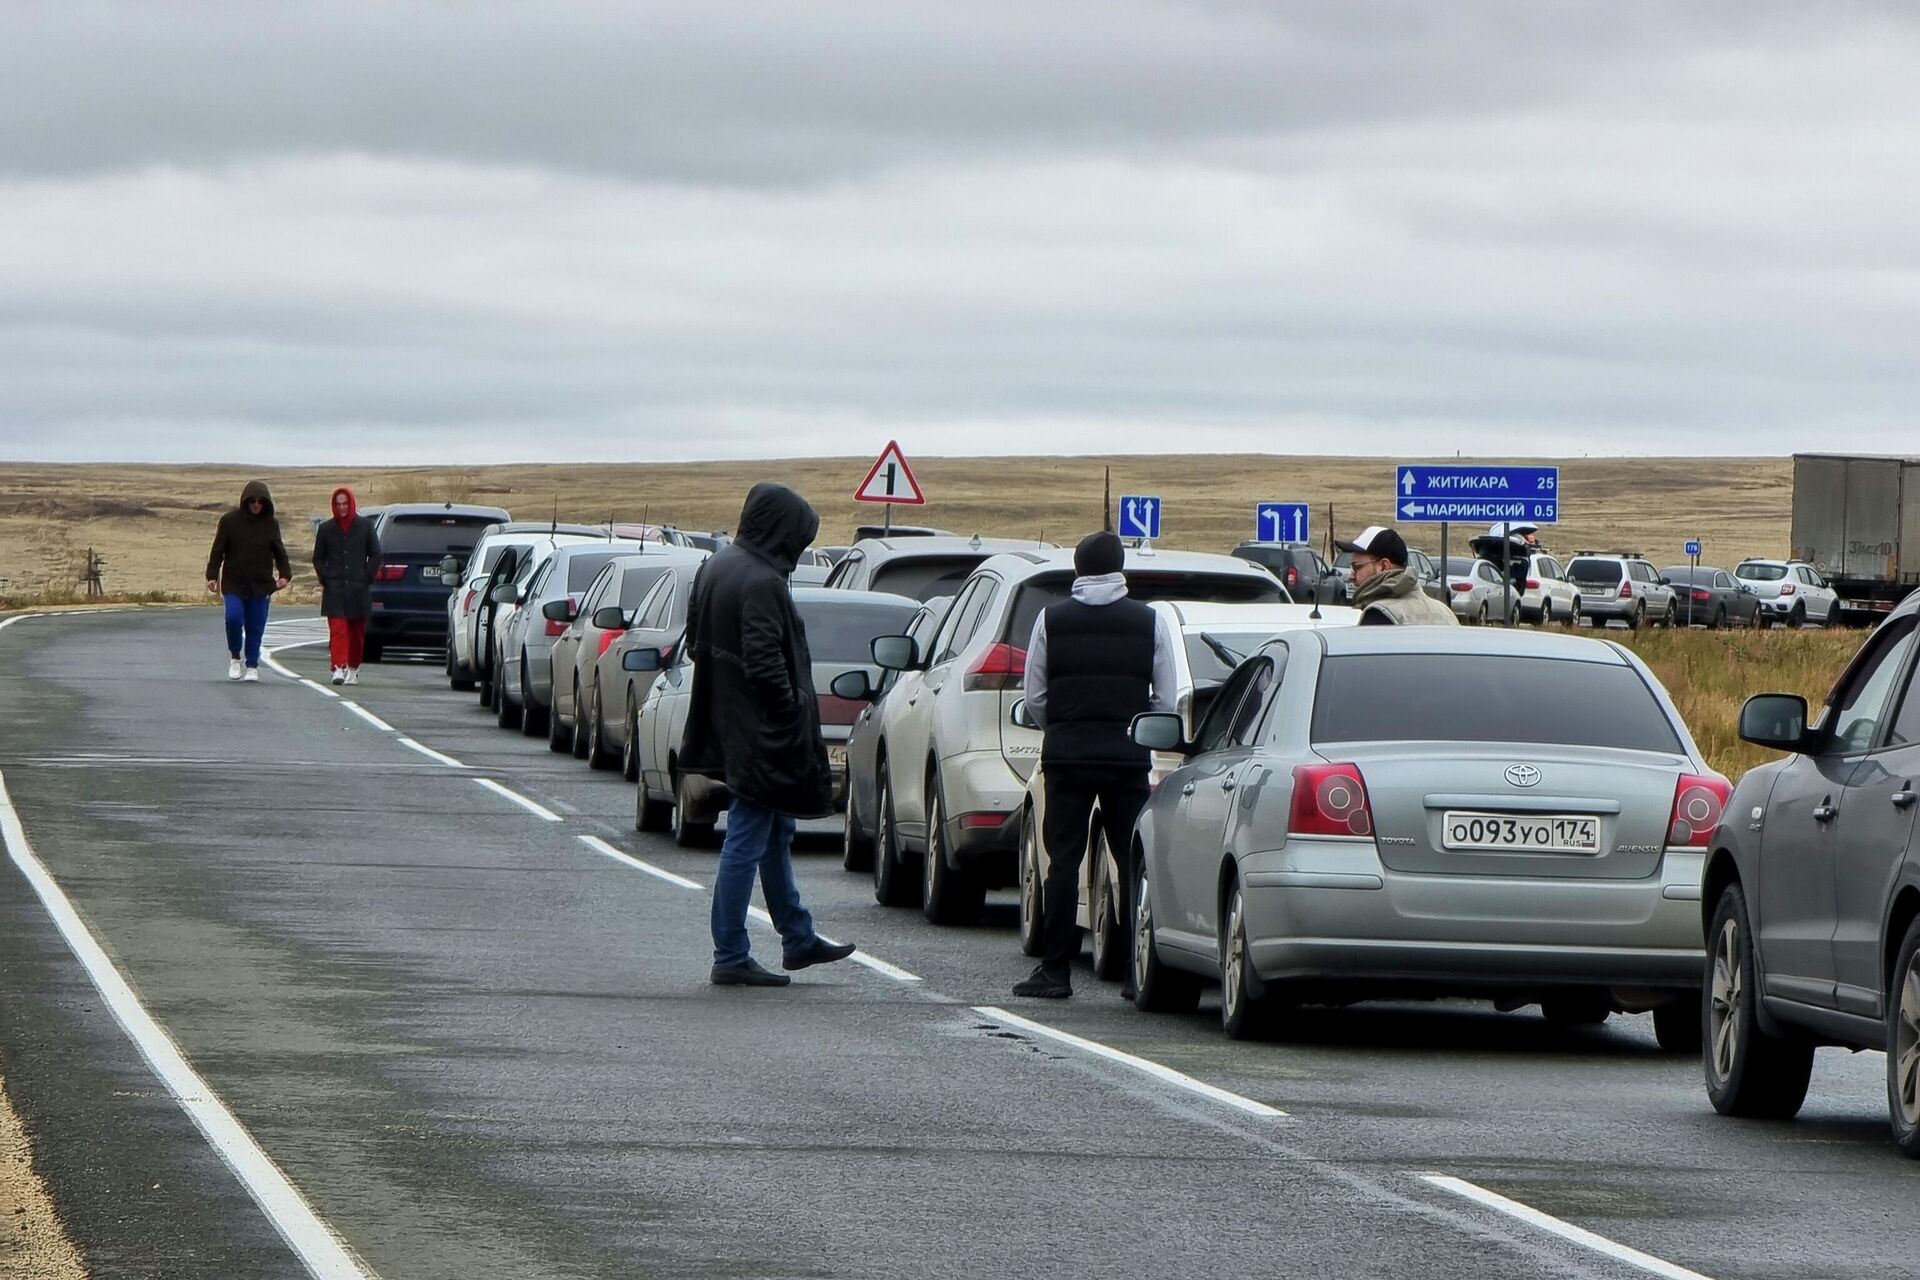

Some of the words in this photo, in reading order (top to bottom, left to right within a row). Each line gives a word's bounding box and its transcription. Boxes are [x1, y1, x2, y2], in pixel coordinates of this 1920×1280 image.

[1427, 476, 1509, 489] ЖИТИКАРА
[1537, 477, 1554, 490] 25
[1426, 502, 1525, 516] МАРИИНСКИЙ
[1534, 505, 1554, 517] 0.5
[1009, 746, 1042, 754] X-TR
[1555, 821, 1591, 841] 174
[1380, 836, 1416, 845] TOYOTA
[1563, 839, 1582, 847] RUS
[1616, 844, 1660, 854] AVENSIS
